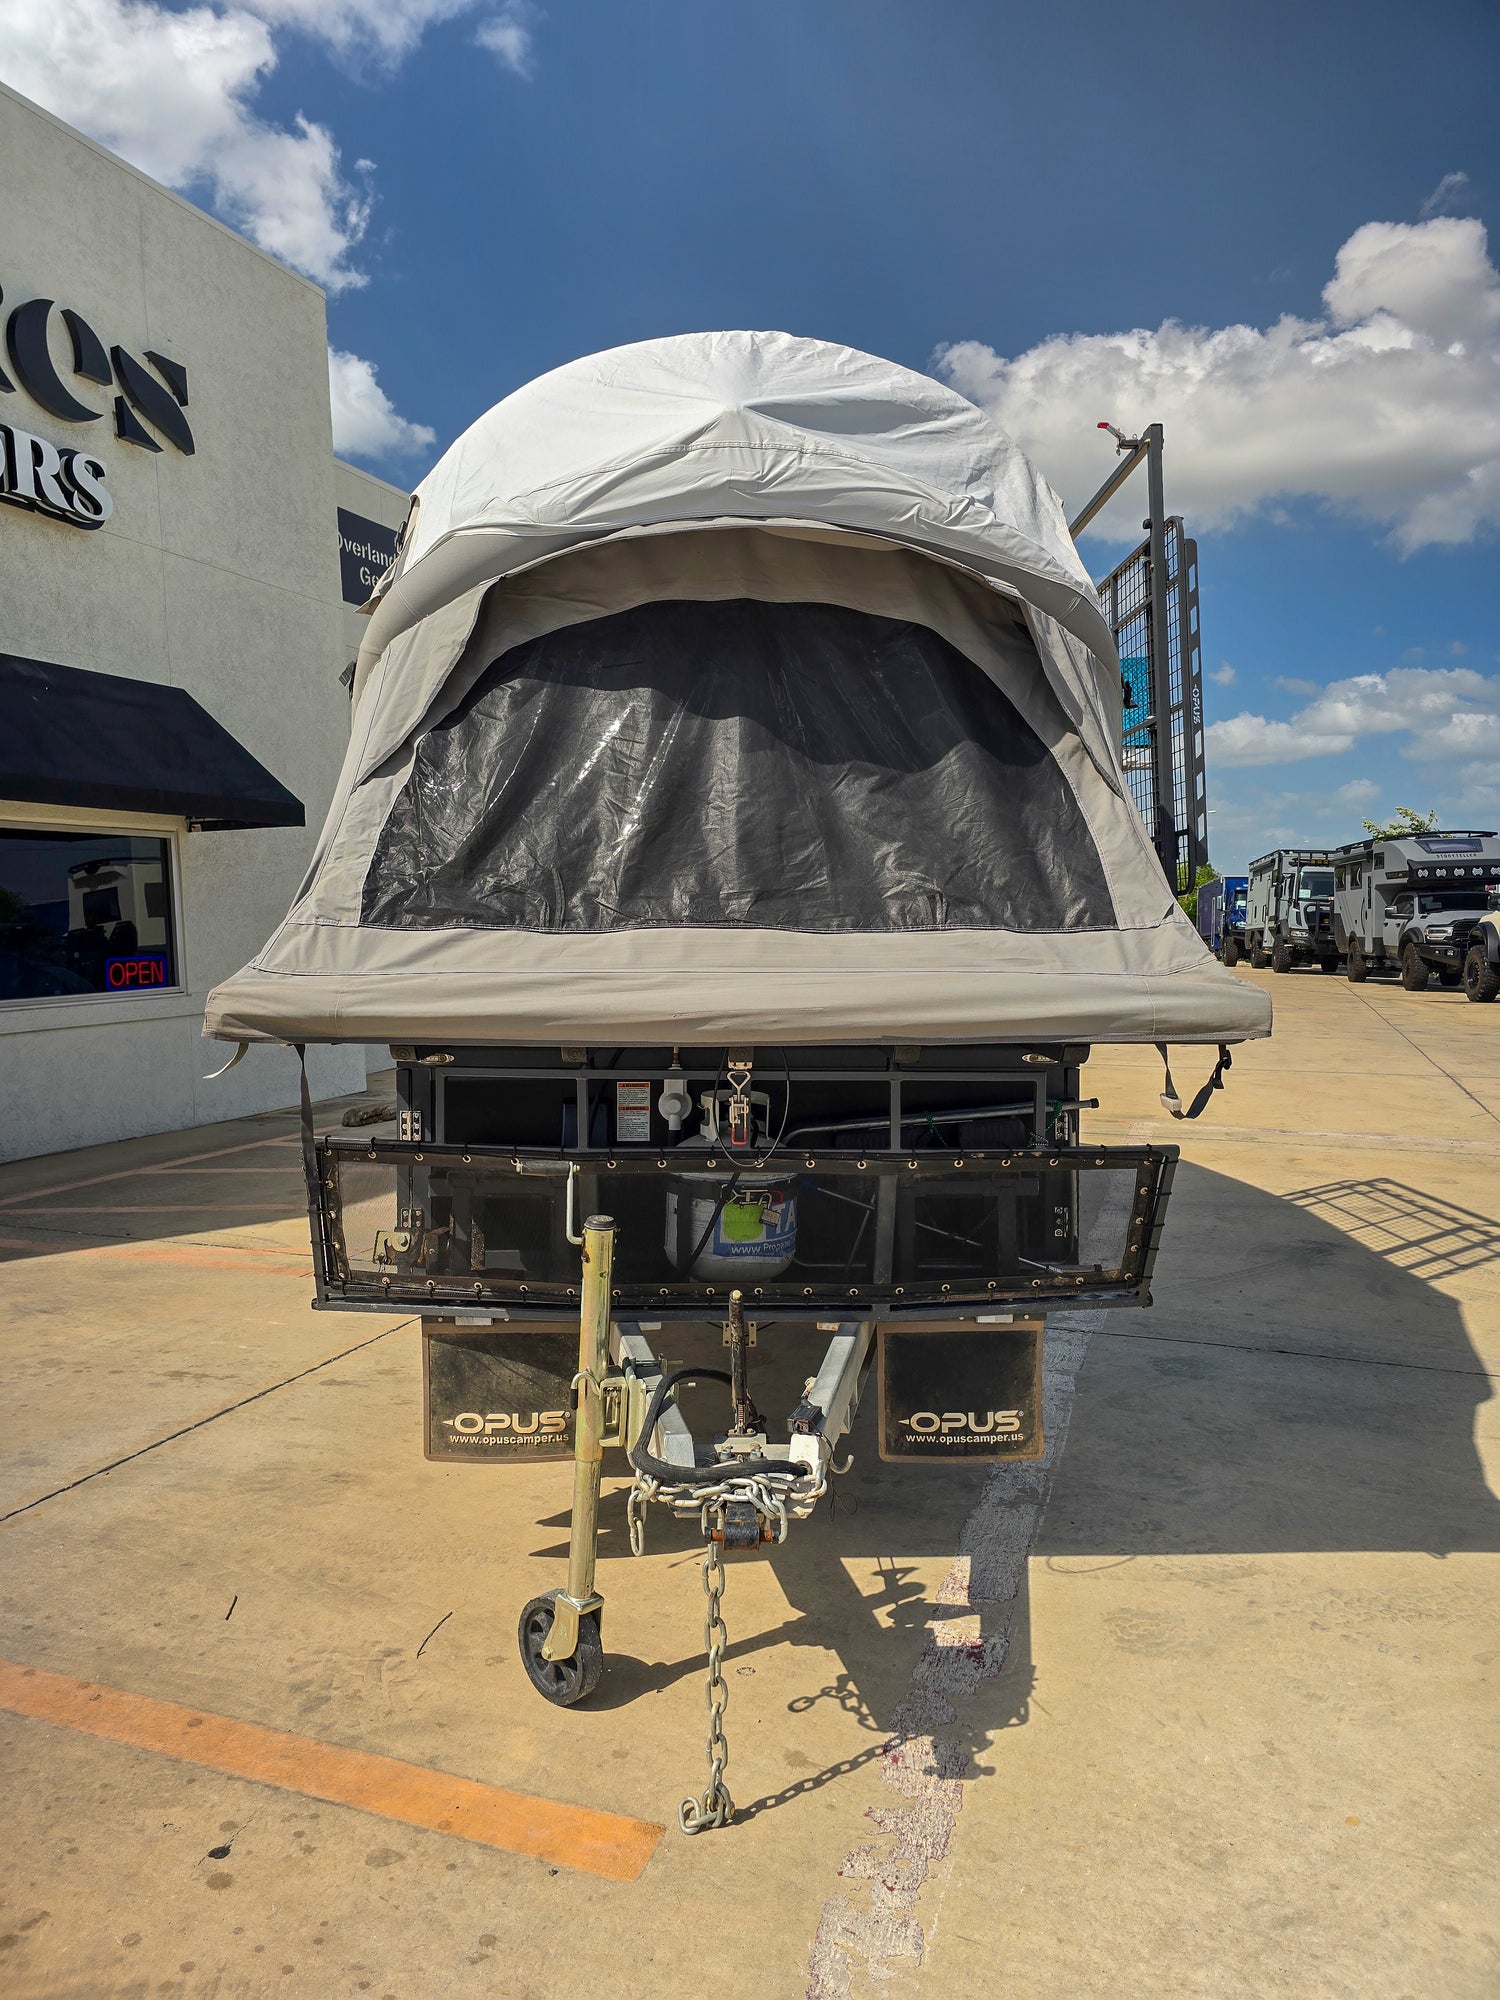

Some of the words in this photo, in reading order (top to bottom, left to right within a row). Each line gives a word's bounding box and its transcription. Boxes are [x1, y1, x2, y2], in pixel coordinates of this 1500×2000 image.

[0, 283, 195, 455] ON
[0, 424, 113, 523] RS
[110, 961, 163, 986] OPEN
[454, 1411, 566, 1434] OPUS
[910, 1410, 1020, 1433] OPUS
[450, 1433, 569, 1446] www.opuscamper.us
[906, 1433, 1024, 1445] www.opuscamper.us
